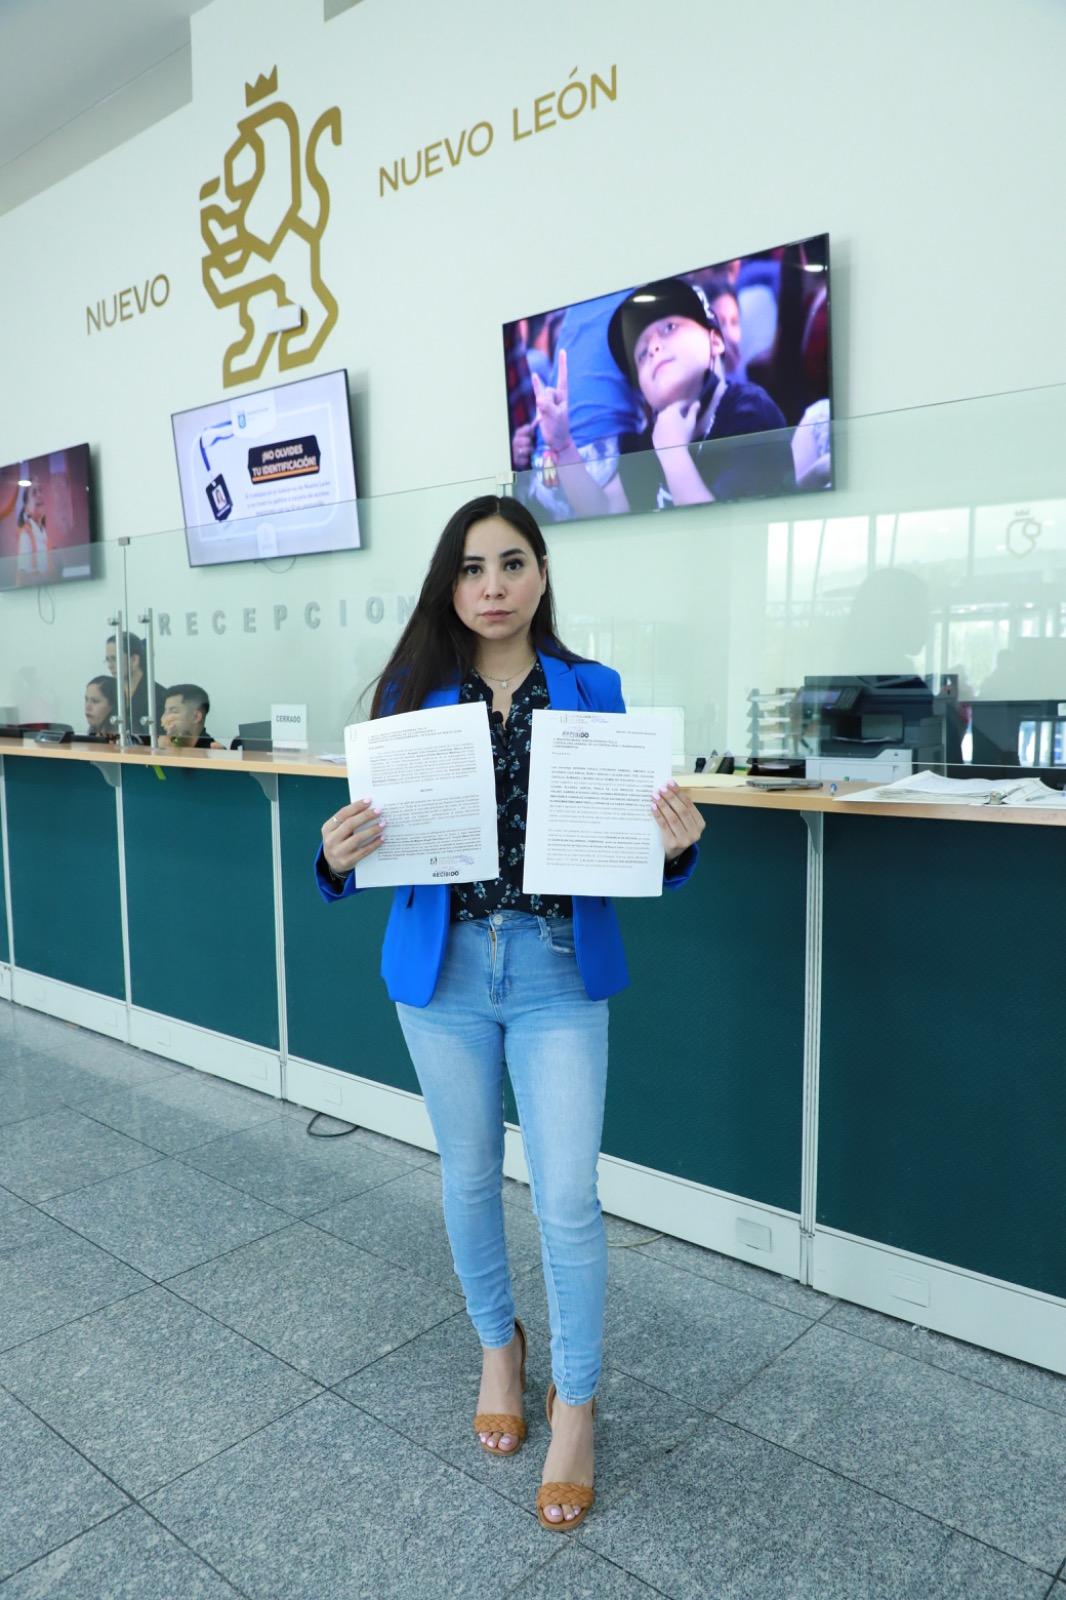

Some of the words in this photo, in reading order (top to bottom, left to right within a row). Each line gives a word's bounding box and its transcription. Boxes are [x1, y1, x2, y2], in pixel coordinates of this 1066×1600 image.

[379, 121, 494, 198] NUEVO
[512, 64, 617, 142] LEÓN
[86, 273, 170, 336] NUEVO
[275, 444, 303, 459] OLVIDES
[252, 466, 261, 476] TU
[275, 715, 302, 723] CERRADO
